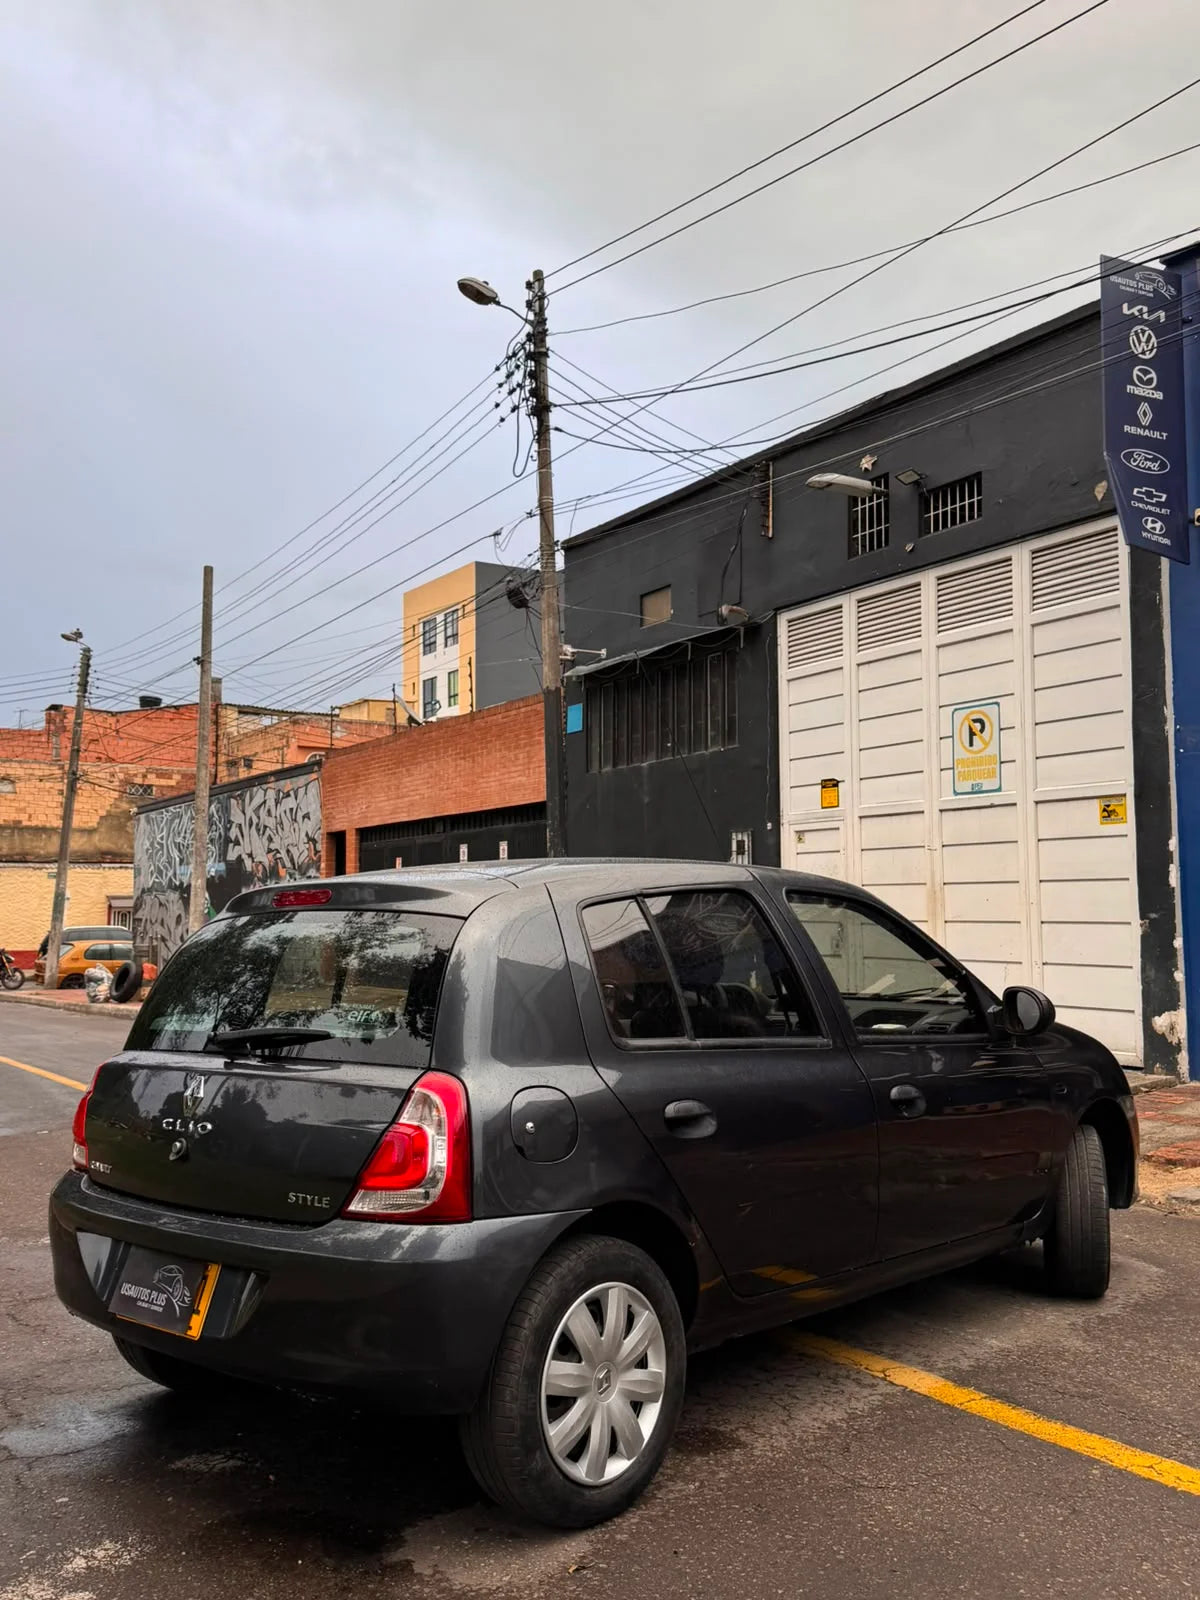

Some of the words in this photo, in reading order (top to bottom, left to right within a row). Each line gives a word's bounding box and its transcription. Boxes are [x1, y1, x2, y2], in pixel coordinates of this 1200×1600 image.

[1138, 282, 1154, 292] PLUS
[1123, 425, 1168, 440] RENAULT
[1130, 451, 1161, 471] Ford
[1131, 500, 1170, 515] CHEVROLET
[956, 754, 997, 769] PROHIBIDO
[957, 767, 997, 782] PARQUEAR
[162, 1118, 213, 1134] CLIO
[287, 1192, 330, 1208] STYLE
[120, 1282, 151, 1302] USAUTOS
[150, 1290, 168, 1306] PLUS
